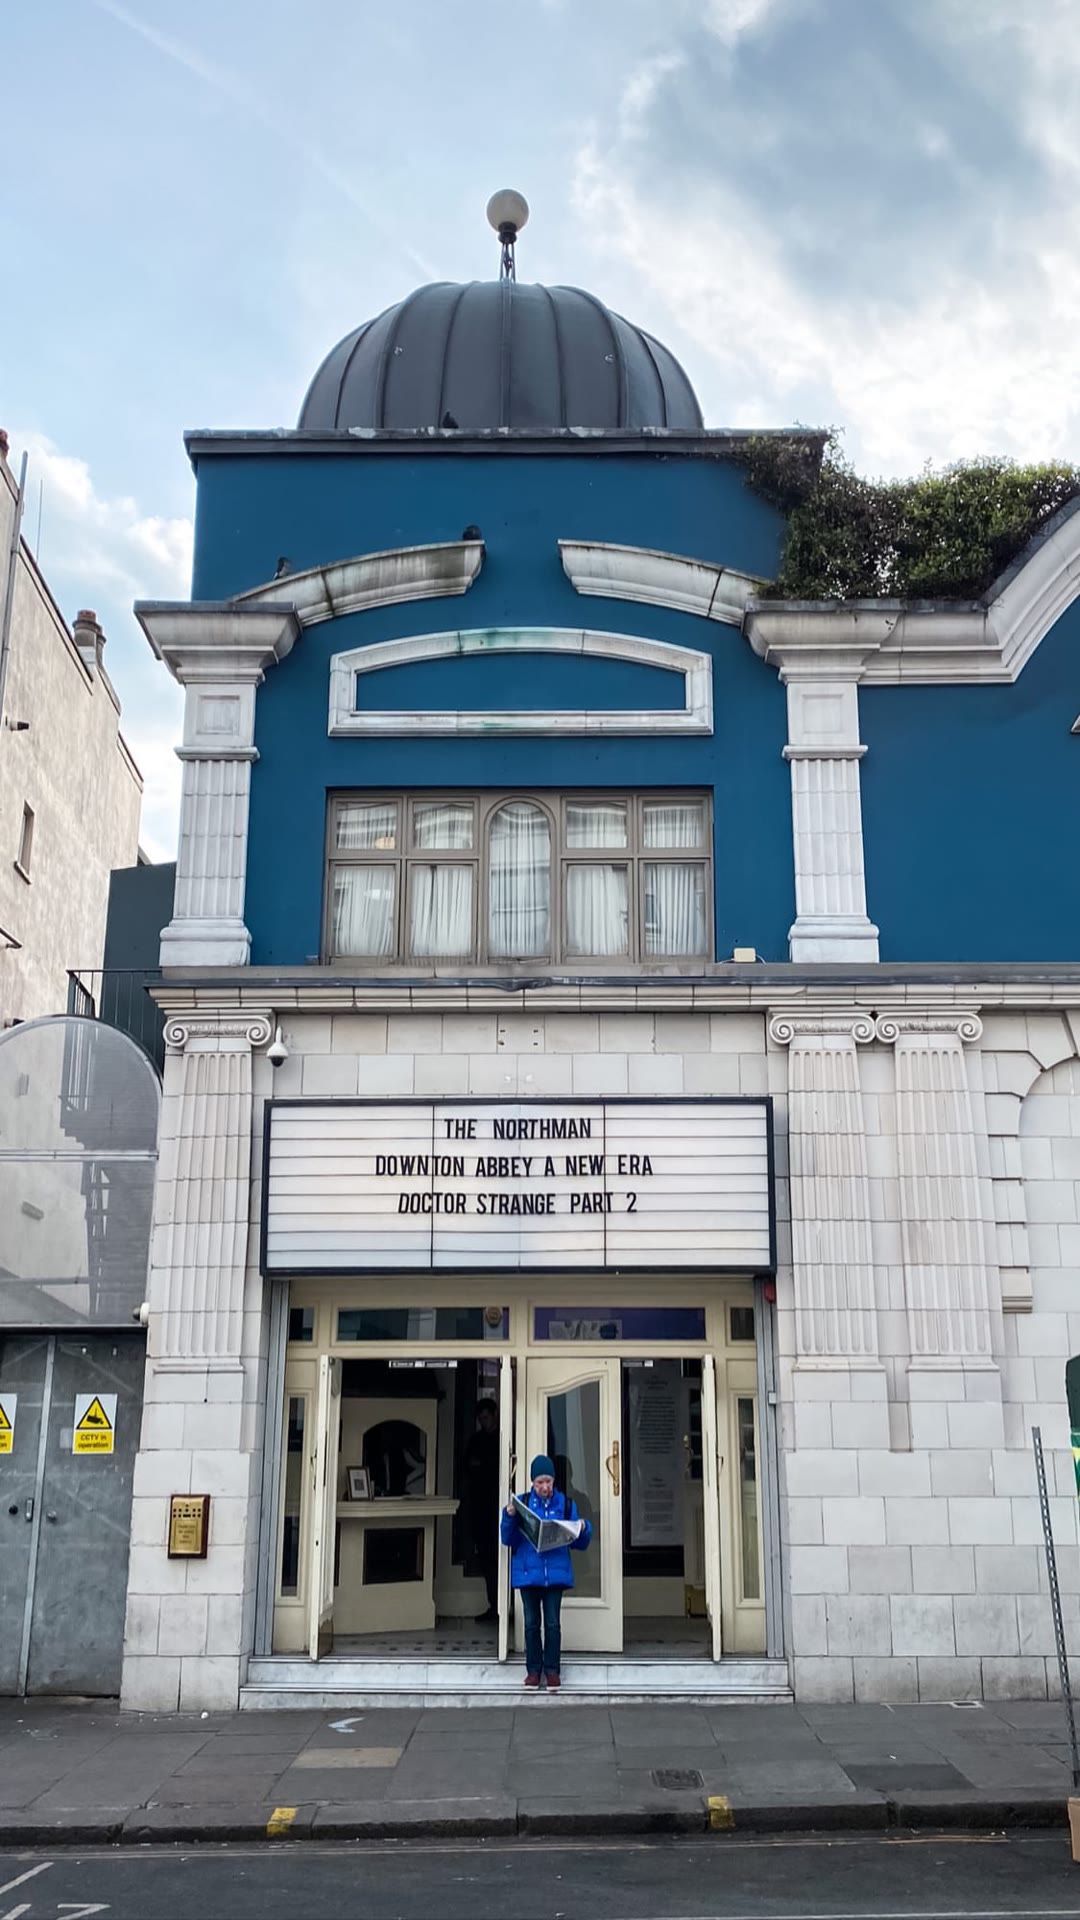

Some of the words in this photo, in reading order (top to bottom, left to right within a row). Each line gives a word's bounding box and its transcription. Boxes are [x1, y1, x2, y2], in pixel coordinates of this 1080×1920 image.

[445, 1119, 477, 1140] THE
[493, 1118, 591, 1140] NORTHMAN
[376, 1156, 464, 1177] DOWNTON
[476, 1156, 532, 1178] ABBEY
[544, 1156, 555, 1177] A
[566, 1155, 604, 1177] NEW
[618, 1154, 653, 1176] ERA
[398, 1192, 466, 1214] DOCTOR
[476, 1193, 555, 1215] STRANGE
[570, 1192, 613, 1214] PART
[626, 1192, 638, 1213] 2
[81, 1433, 99, 1441] CCTV
[101, 1433, 107, 1441] in
